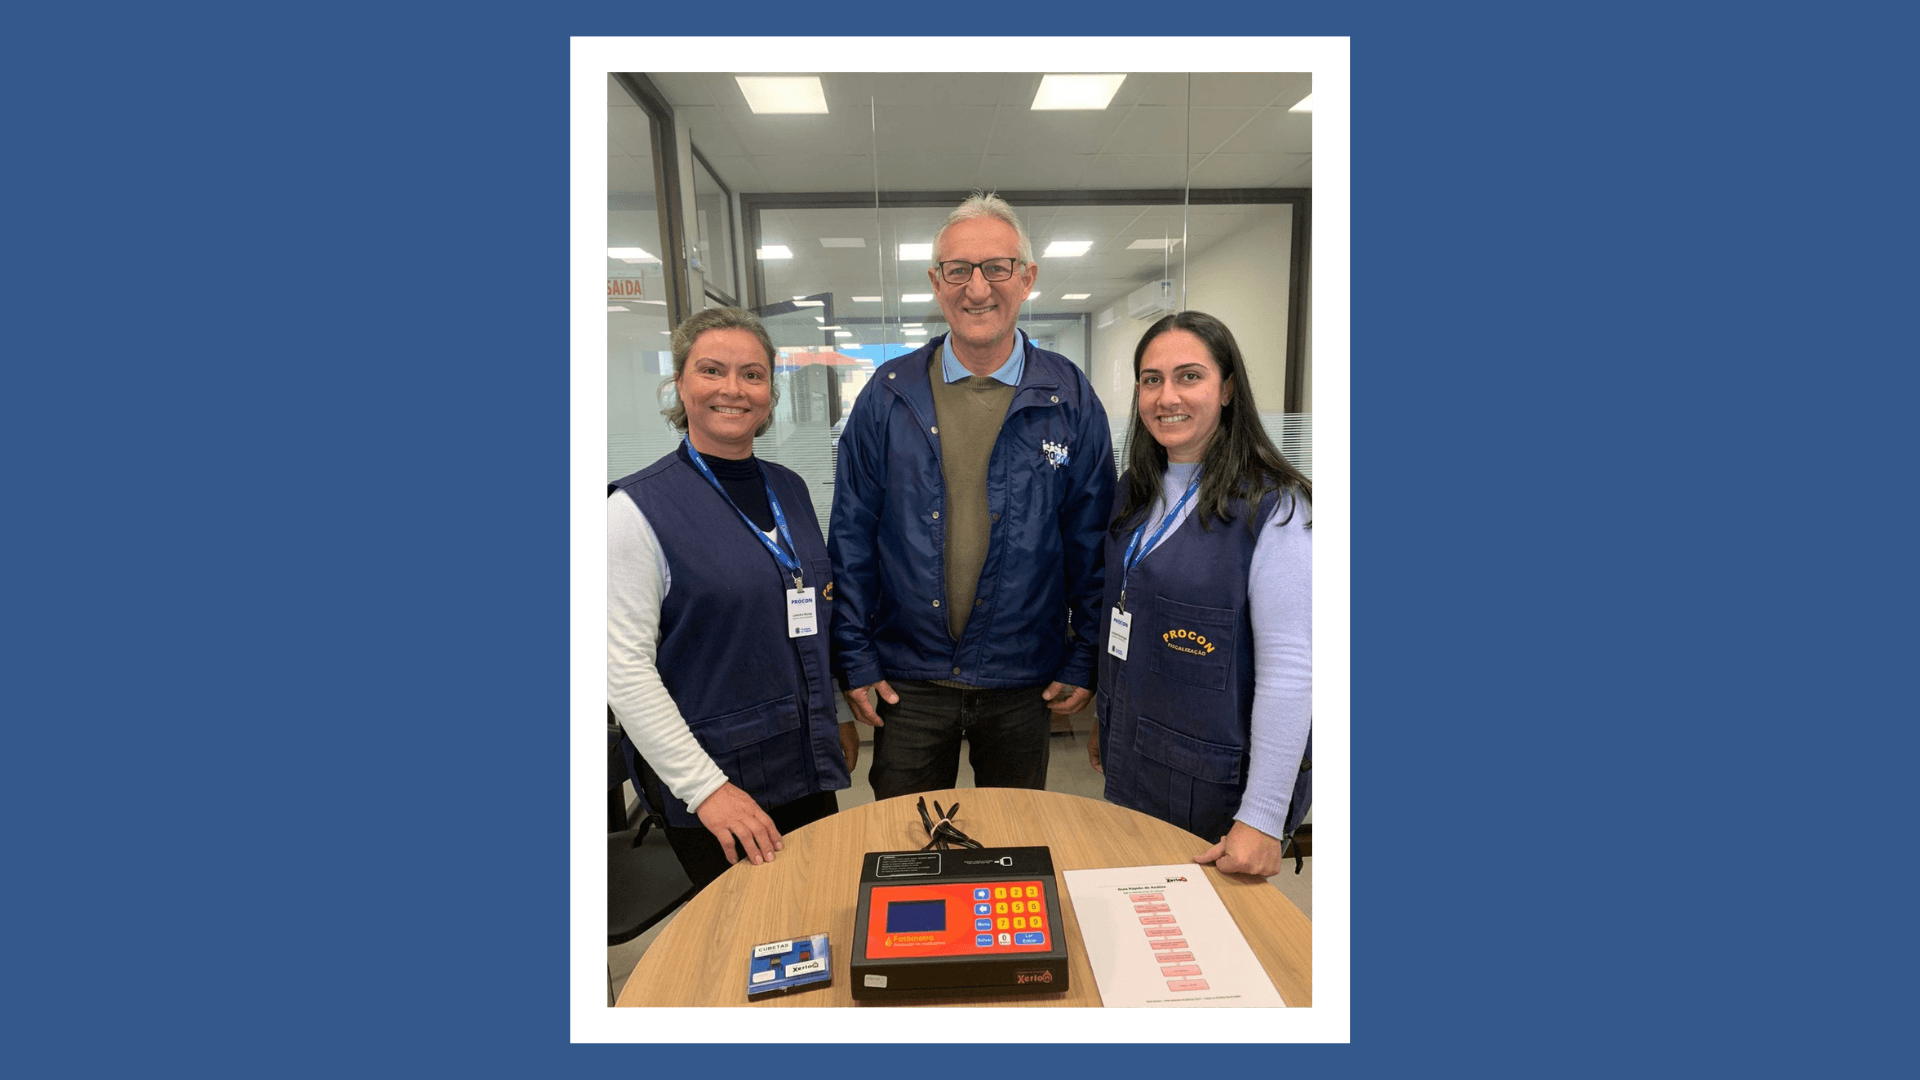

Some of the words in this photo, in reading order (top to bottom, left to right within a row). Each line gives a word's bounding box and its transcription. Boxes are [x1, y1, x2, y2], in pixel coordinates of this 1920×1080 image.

[607, 279, 642, 296] SAÍDA
[1162, 628, 1215, 653] PROCON
[1167, 642, 1207, 656] FISCALIZAÇÃO
[758, 943, 789, 953] CUBETAS
